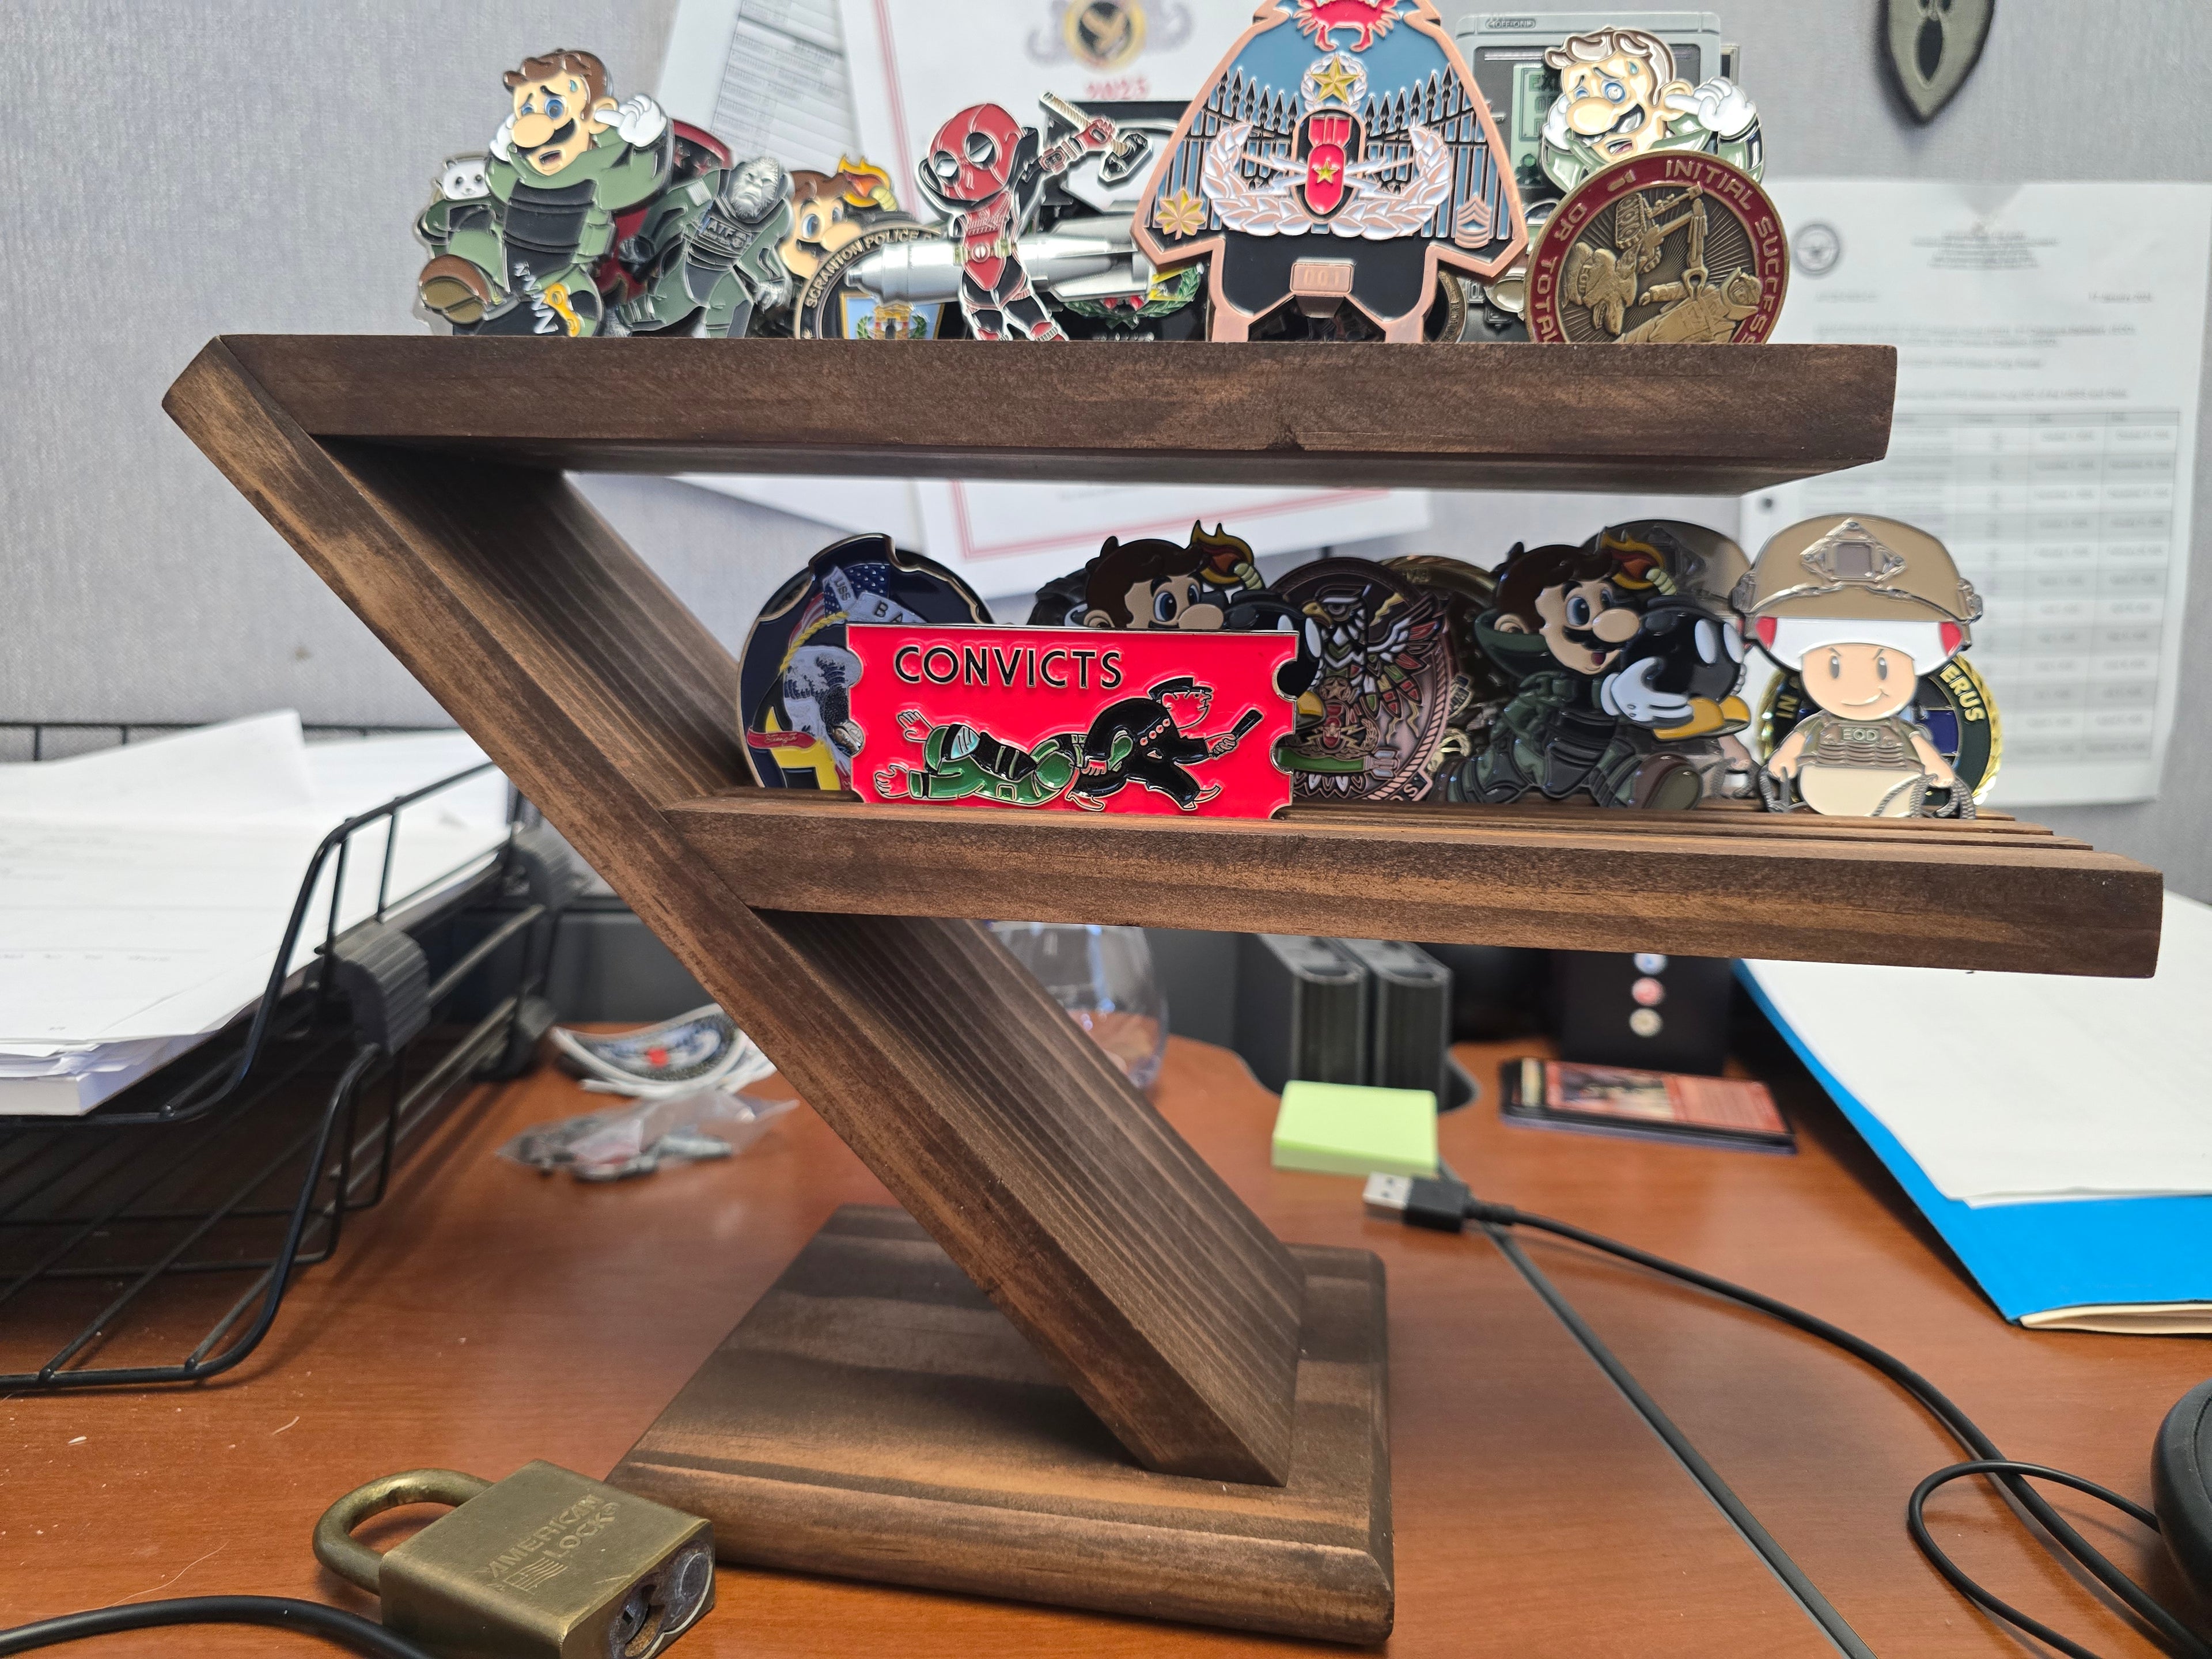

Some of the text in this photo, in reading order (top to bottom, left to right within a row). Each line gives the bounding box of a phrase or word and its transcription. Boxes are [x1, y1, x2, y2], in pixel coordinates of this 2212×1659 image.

[706, 219, 737, 237] ATF
[1554, 202, 1586, 241] OR
[804, 228, 919, 308] SCRANTON POLICE
[1665, 159, 1779, 344] INITIAL SUCCESS
[834, 577, 851, 601] USS
[893, 644, 1123, 690] CONVICTS
[1775, 693, 1798, 719] IN
[1843, 728, 1877, 742] EOD
[490, 1494, 601, 1578] AMERICAN
